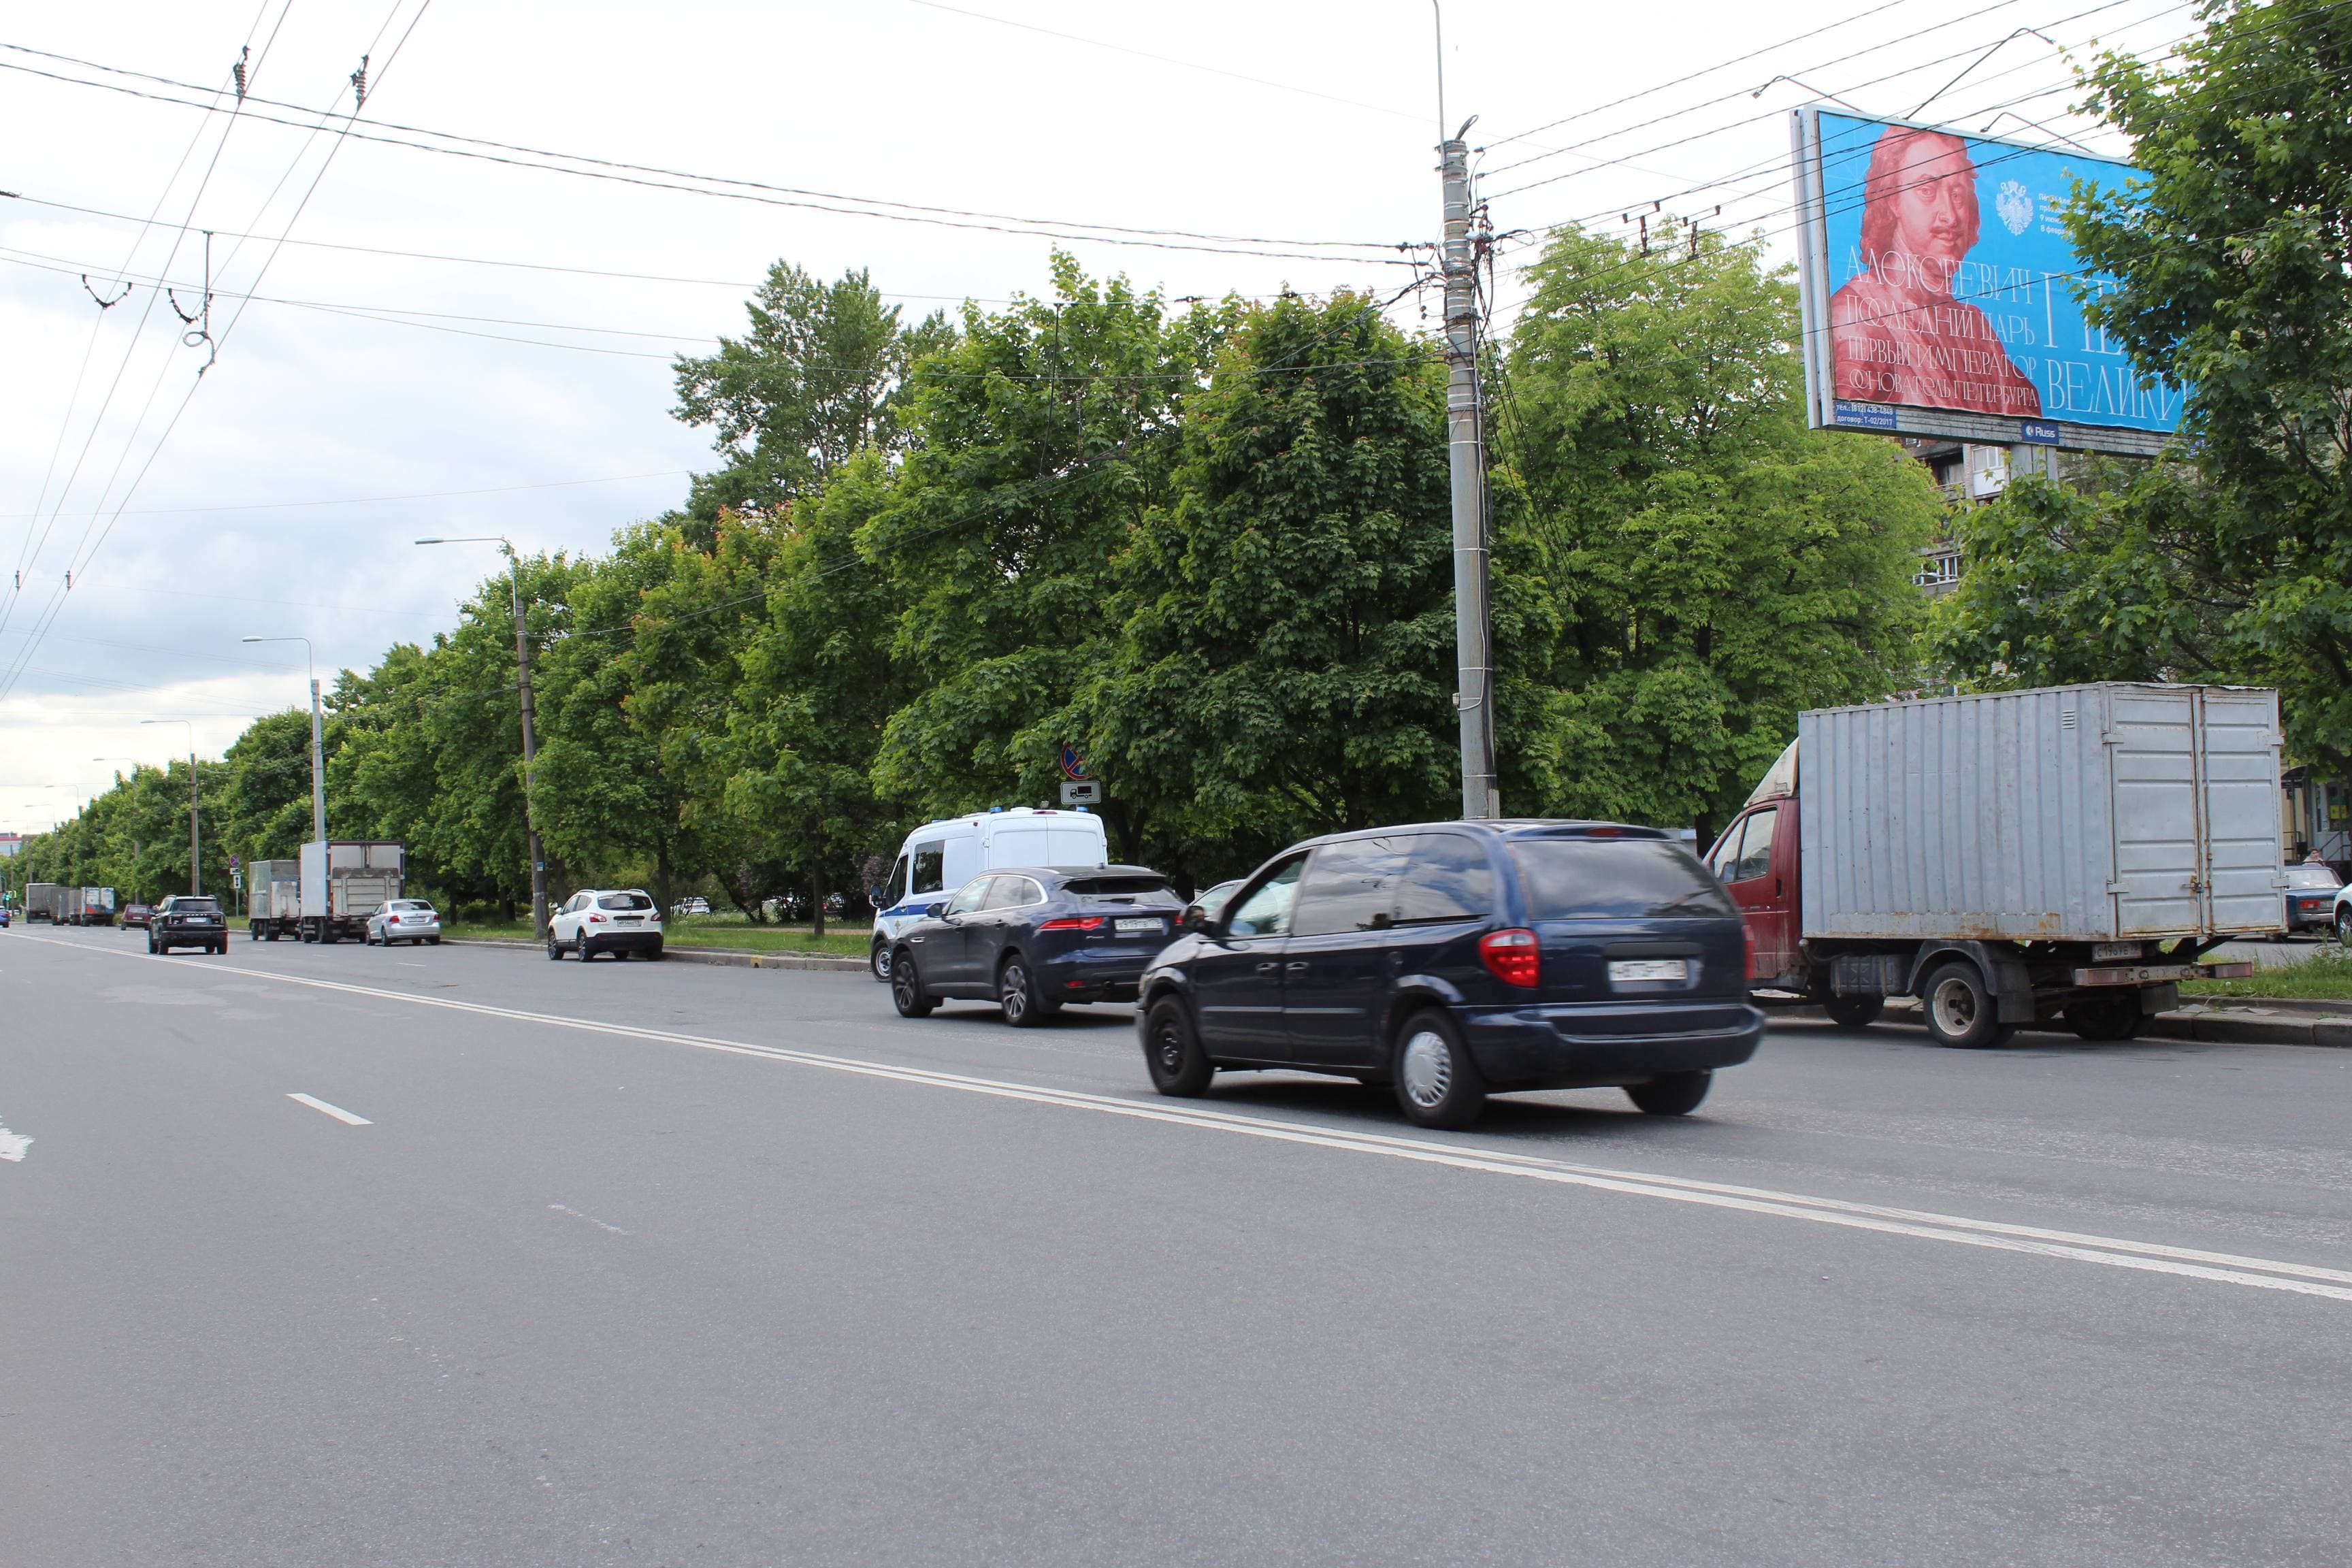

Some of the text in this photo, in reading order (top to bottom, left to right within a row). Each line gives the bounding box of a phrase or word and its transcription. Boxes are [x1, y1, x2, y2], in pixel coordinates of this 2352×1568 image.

[1980, 312, 2035, 348] ЦАРЬ
[1848, 333, 2036, 380] ПЕРВЫЙ ИМПЕРАТОР
[1954, 380, 2038, 407] ПЕТЕРБУРГА
[2035, 426, 2055, 438] Russ
